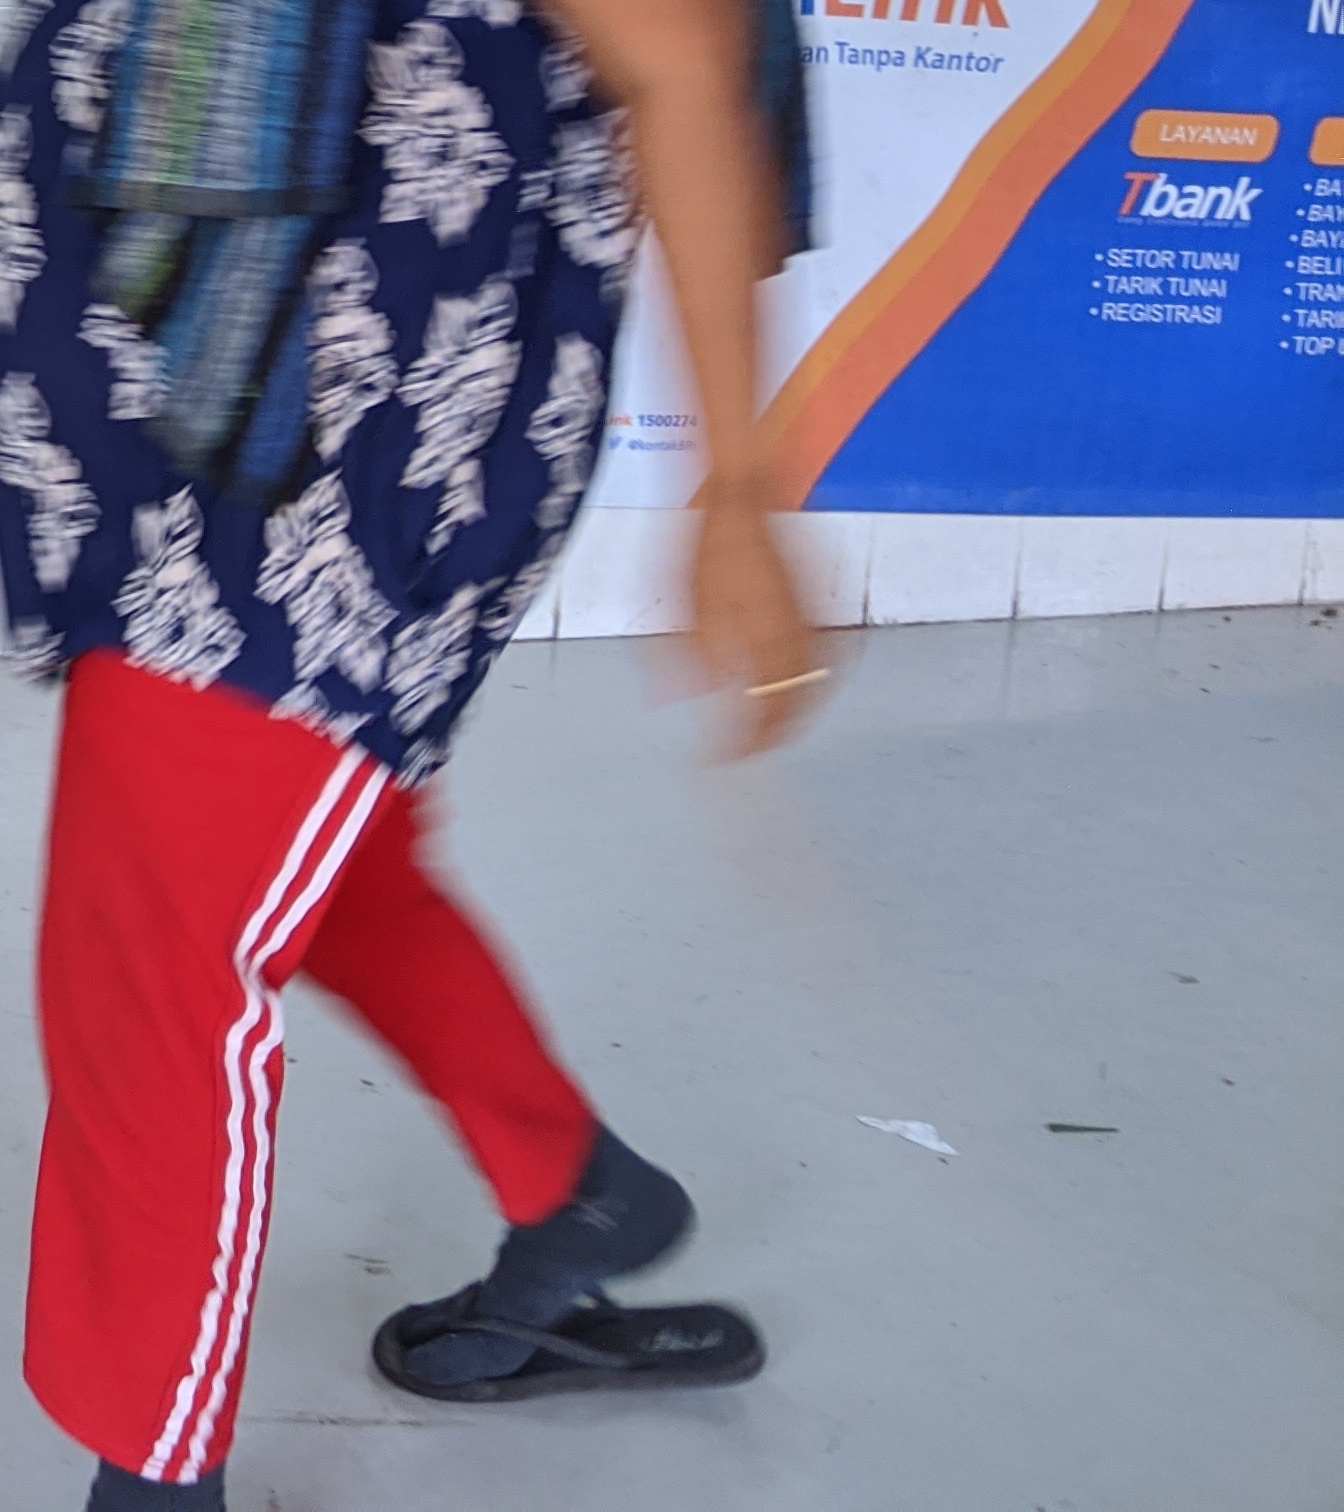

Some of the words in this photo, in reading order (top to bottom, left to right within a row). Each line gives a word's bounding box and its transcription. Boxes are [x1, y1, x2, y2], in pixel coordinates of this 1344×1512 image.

[834, 41, 906, 73] Tanpa
[912, 45, 1005, 74] Kantor
[1160, 124, 1258, 146] LAYANAN
[1119, 172, 1264, 221] Tbank
[1106, 248, 1176, 268] SETOR
[1179, 251, 1240, 271] TUNAI
[1104, 275, 1164, 295] TARIK
[1166, 277, 1228, 298] TUNAI
[1101, 302, 1223, 324] REGISTRASI
[1292, 335, 1335, 356] TOP
